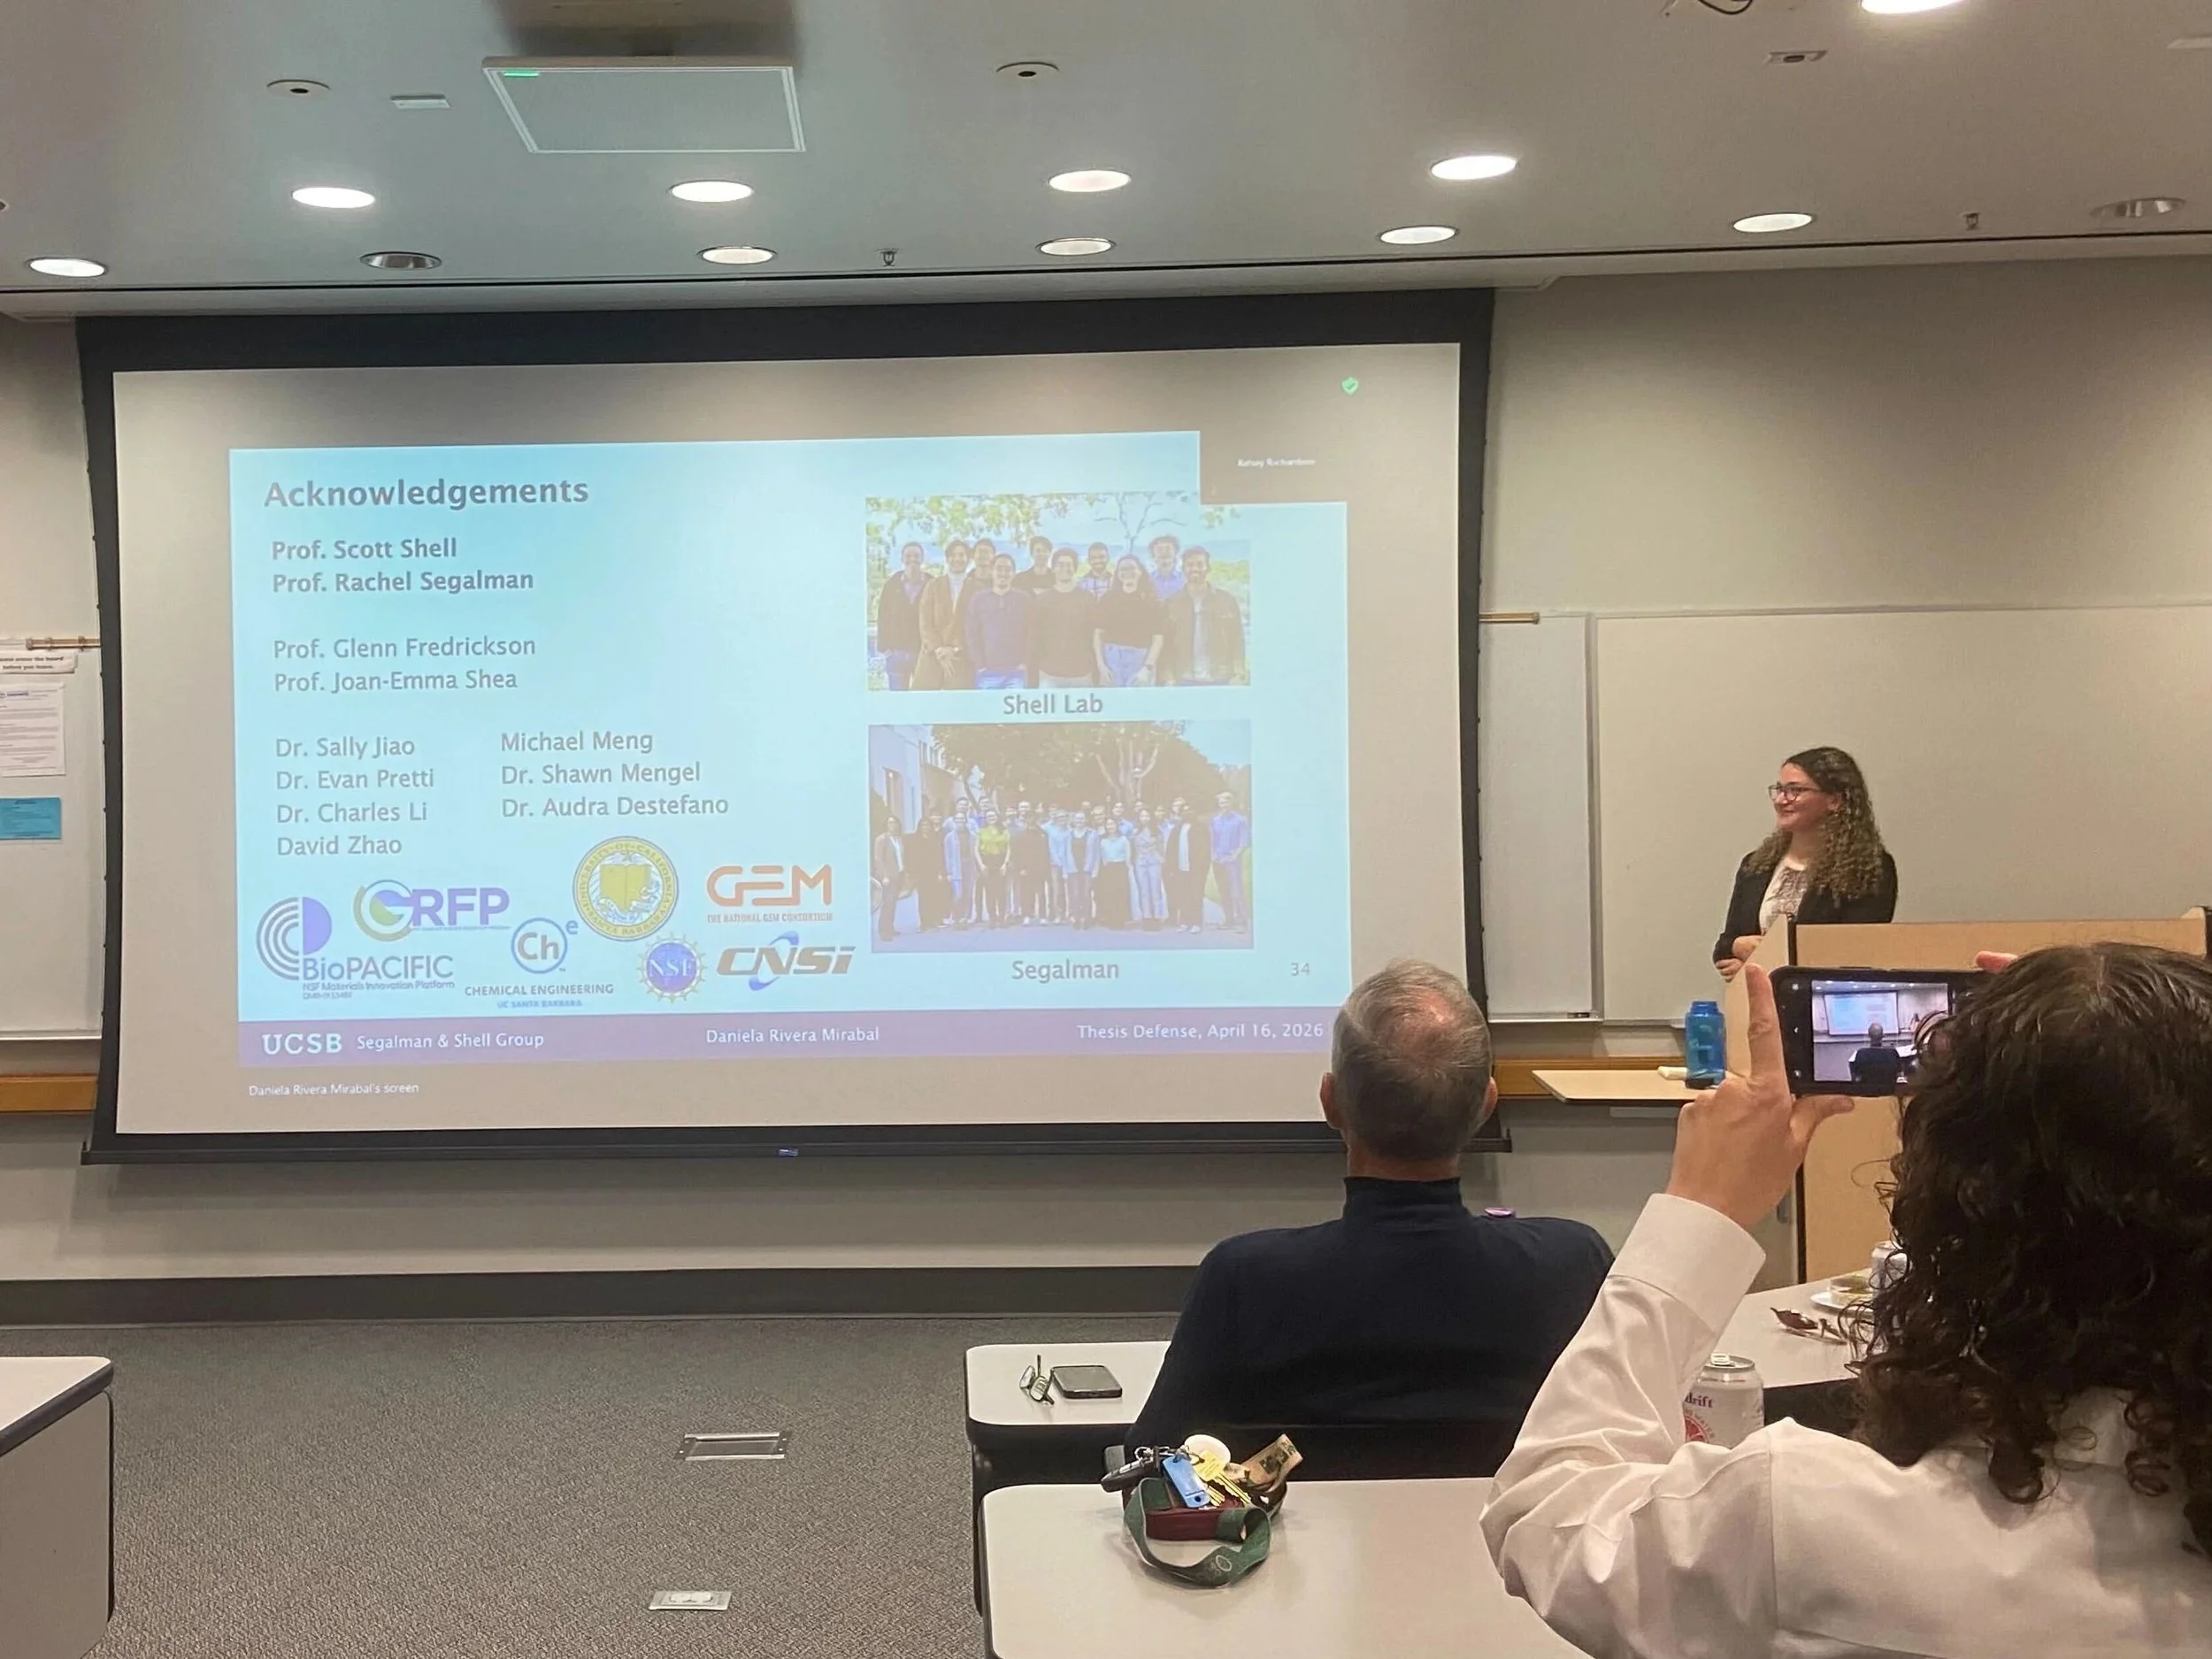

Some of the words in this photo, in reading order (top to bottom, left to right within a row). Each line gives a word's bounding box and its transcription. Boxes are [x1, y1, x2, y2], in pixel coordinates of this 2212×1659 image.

[265, 479, 589, 511] Acknowledgements
[272, 541, 327, 560] Prof.
[334, 540, 393, 559] Scott
[400, 538, 457, 558] Shell
[273, 573, 327, 593] Prof.
[335, 572, 411, 592] Rachel
[420, 571, 534, 594] Segalman
[273, 640, 325, 659] Prof.
[334, 638, 398, 658] Glenn
[405, 636, 536, 657] Fredrickson
[274, 672, 325, 692] Prof.
[332, 671, 458, 694] Joan-Emma
[465, 670, 518, 689] Shea
[1003, 694, 1055, 715] Shell
[1064, 694, 1103, 713] Lab
[276, 738, 308, 757] Dr.
[317, 737, 366, 759] Sally
[373, 737, 416, 759] Jiao
[501, 732, 584, 752] Michael
[593, 731, 653, 754] Meng
[276, 772, 309, 790] Dr.
[318, 771, 368, 789] Evan
[377, 769, 434, 788] Pretti
[502, 765, 534, 785] Dr.
[541, 764, 612, 784] Shawn
[620, 762, 702, 786] Mengel
[276, 804, 310, 824] Dr.
[318, 803, 401, 823] Charles
[410, 803, 428, 821] Li
[503, 799, 534, 818] Dr.
[542, 796, 610, 817] Audra
[618, 795, 729, 816] Destefano
[277, 836, 339, 856] David
[348, 835, 403, 855] Zhao
[706, 864, 833, 907] GEM
[303, 956, 453, 981] BioPACIFIC
[649, 957, 697, 978] NSF
[1011, 959, 1119, 984] Segalman
[1290, 962, 1311, 977] 34
[465, 986, 527, 996] CHEMICAL
[530, 984, 614, 995] ENGINEERING
[706, 1029, 764, 1044] Daniela
[769, 1028, 817, 1042] Rivera
[822, 1027, 879, 1042] Mirabal
[1077, 1025, 1128, 1040] Thesis
[1133, 1025, 1202, 1041] Defense,
[1207, 1024, 1245, 1041] April
[1252, 1024, 1276, 1039] 16,
[1282, 1024, 1325, 1038] 2026
[261, 1033, 343, 1056] UCSB
[357, 1034, 432, 1051] Segalman
[437, 1033, 449, 1048] &
[454, 1033, 490, 1048] Shell
[495, 1033, 544, 1050] Group
[249, 1084, 290, 1096] Daniela
[293, 1084, 327, 1095] Rivera
[330, 1083, 381, 1094] Mirabal's
[384, 1084, 419, 1094] screen
